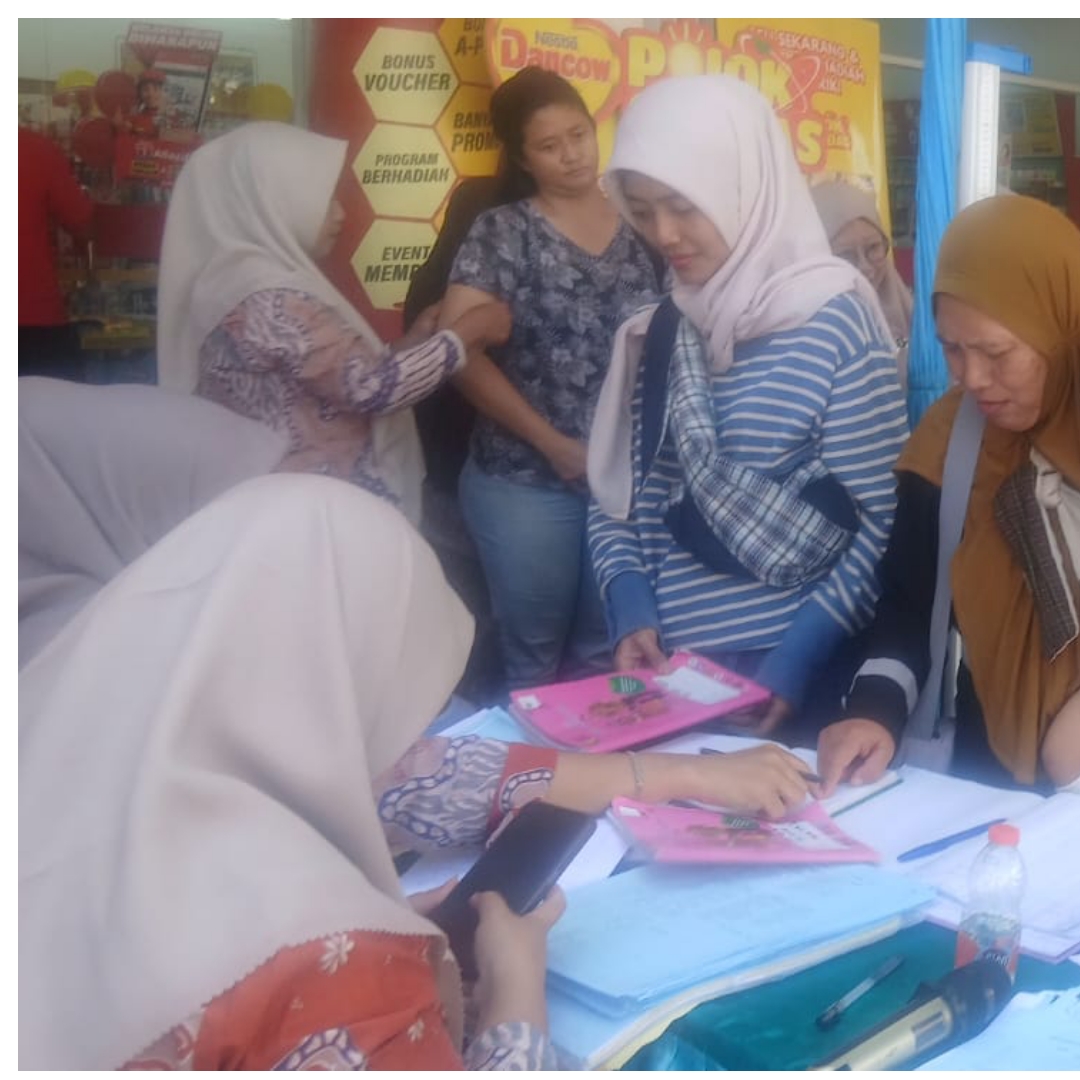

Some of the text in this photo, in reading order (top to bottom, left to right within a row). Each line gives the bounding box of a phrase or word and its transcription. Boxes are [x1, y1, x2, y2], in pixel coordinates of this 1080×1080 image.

[381, 54, 436, 70] BONUS
[500, 27, 611, 83] Dancow
[364, 73, 451, 93] VOUCHER
[375, 152, 439, 167] PROGRAM
[362, 168, 450, 185] BERHADIAH
[381, 245, 431, 262] EVENT
